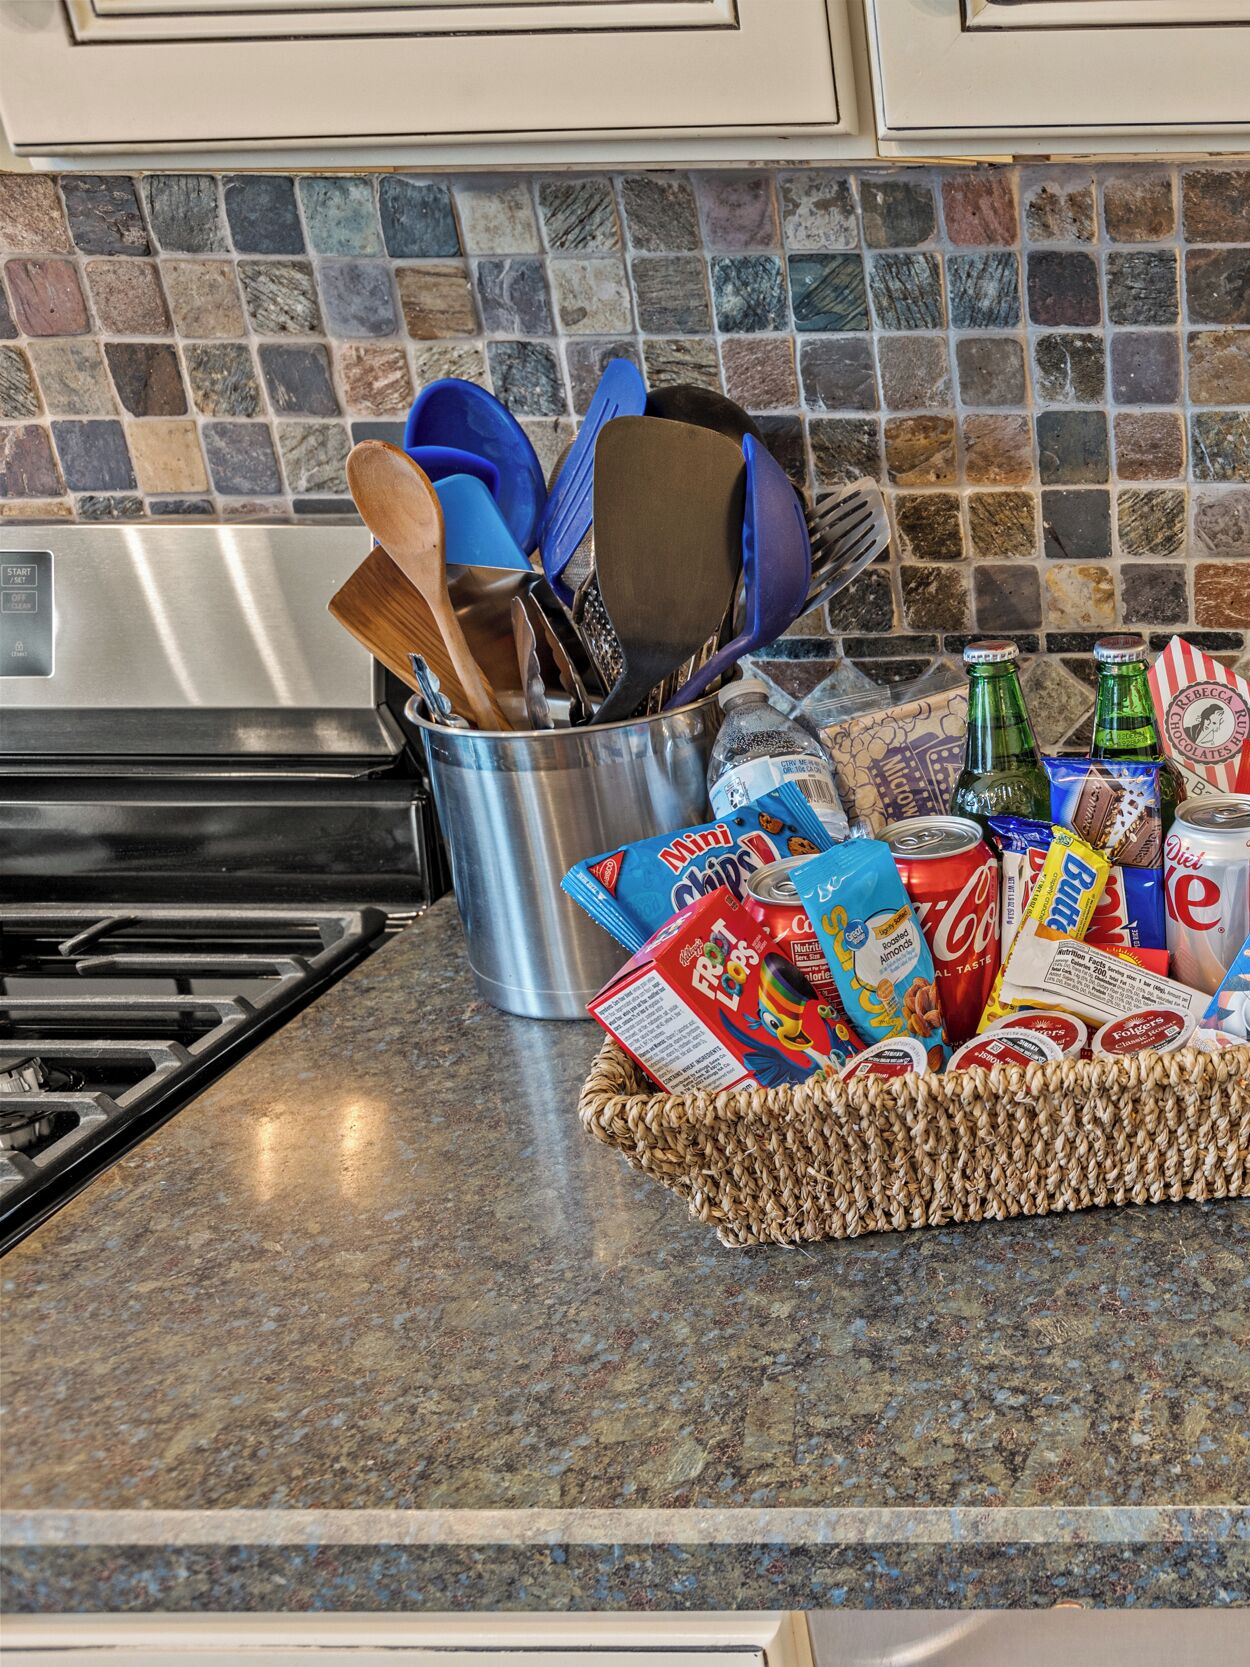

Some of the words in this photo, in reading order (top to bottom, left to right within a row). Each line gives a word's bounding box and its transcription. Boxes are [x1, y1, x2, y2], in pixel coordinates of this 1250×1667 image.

[7, 568, 31, 576] START
[1179, 687, 1234, 712] REBECCA
[1230, 708, 1247, 746] RUTH
[1170, 714, 1233, 760] CHOCOLATES
[1081, 780, 1102, 836] CRUNCH
[659, 823, 733, 874] Mini
[1166, 834, 1205, 870] Diet
[1007, 876, 1015, 884] NET
[1007, 885, 1015, 893] WT
[680, 939, 703, 966] Kellogg's
[880, 938, 914, 965] Almonds
[882, 929, 909, 951] Roasted
[692, 918, 738, 1000] FROOT
[956, 955, 992, 974] TASTE
[1057, 949, 1086, 960] Nutrition
[1088, 956, 1106, 969] Facts
[1107, 966, 1125, 977] Serving
[1071, 958, 1091, 971] Calories
[716, 941, 759, 1012] LOOPS
[1094, 974, 1117, 988] Cholesterol
[1091, 986, 1107, 996] Protein
[1112, 1016, 1164, 1040] Folgers
[1115, 1036, 1148, 1049] Classic
[1149, 1022, 1172, 1037] Roast
[1018, 1037, 1039, 1052] KEURIG
[662, 1069, 682, 1085] CONTAINS
[681, 1062, 695, 1073] WHEAT
[694, 1045, 722, 1065] INGREDIENTS
